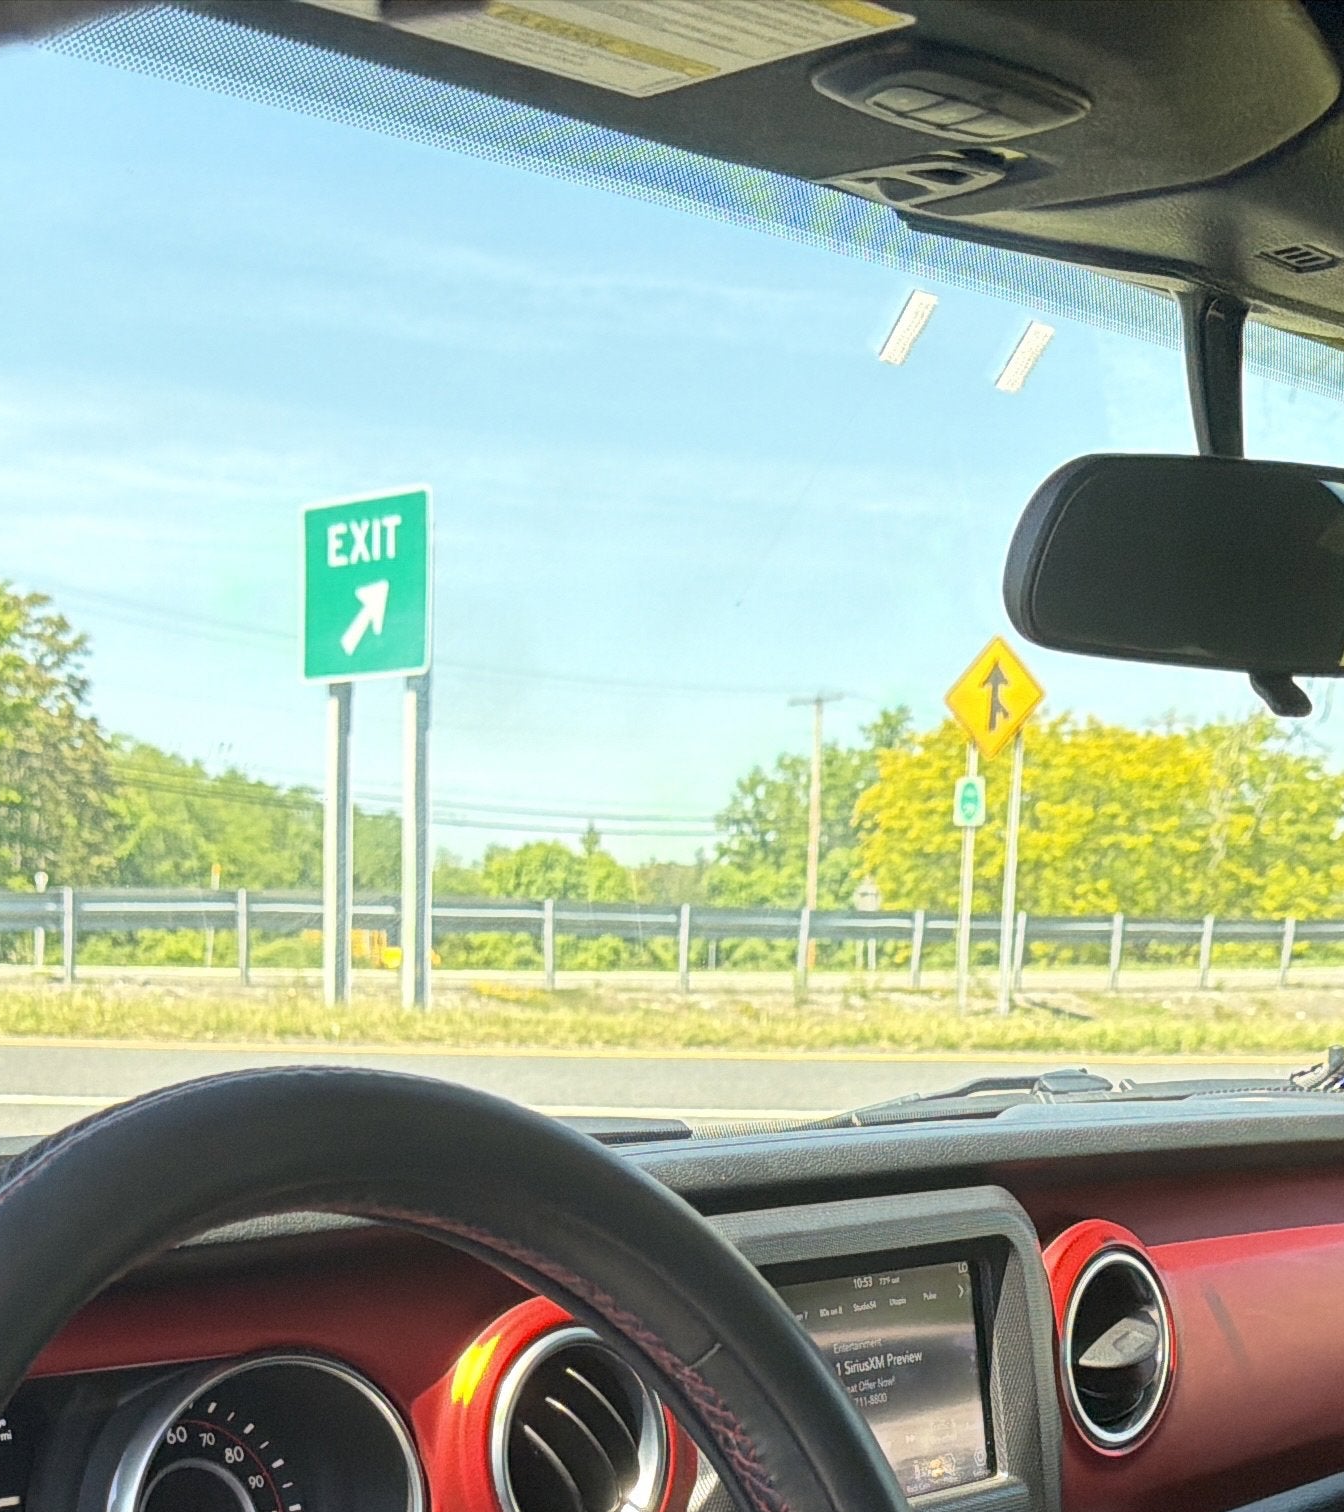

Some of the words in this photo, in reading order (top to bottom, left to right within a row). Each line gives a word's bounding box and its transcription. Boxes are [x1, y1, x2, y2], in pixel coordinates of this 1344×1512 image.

[327, 514, 402, 568] EXIT
[853, 1276, 873, 1289] 10:53
[833, 1338, 882, 1354] Entertainment
[844, 1354, 886, 1376] SiriusXM
[886, 1349, 923, 1368] Preview
[0, 1429, 13, 1442] mi
[166, 1426, 188, 1445] 60
[199, 1432, 216, 1448] 70
[224, 1446, 244, 1465] 80
[248, 1475, 265, 1489] 90
